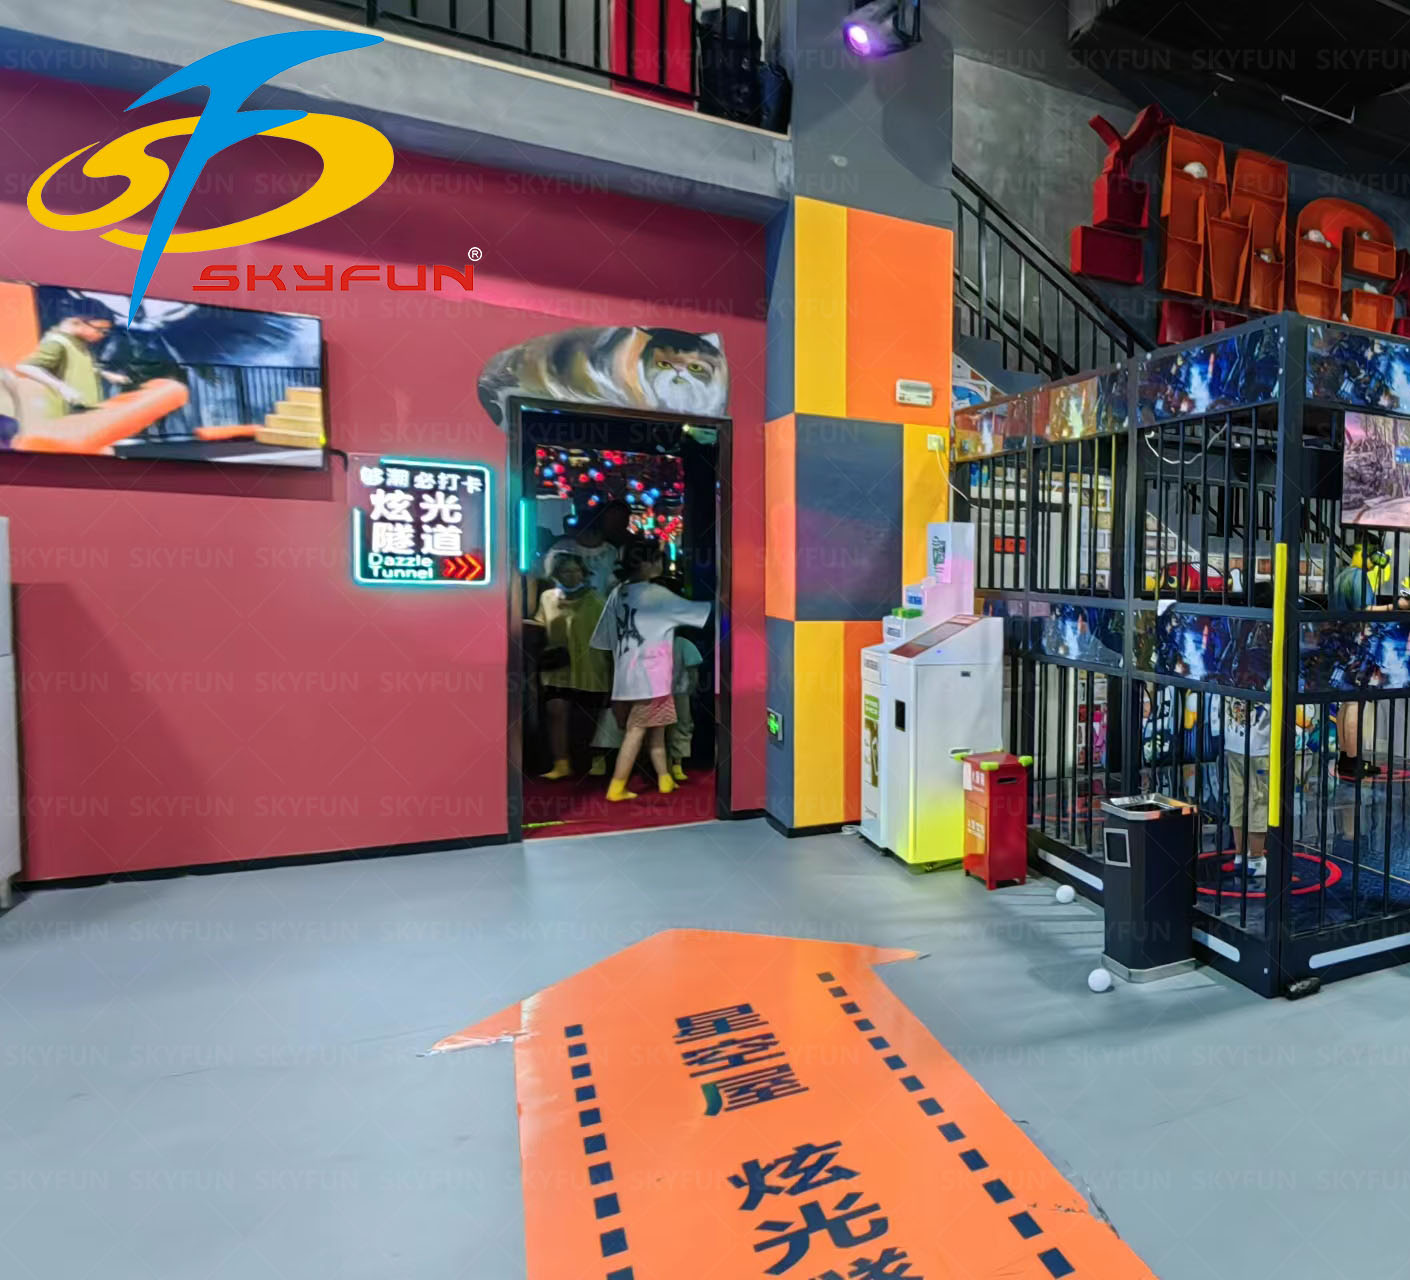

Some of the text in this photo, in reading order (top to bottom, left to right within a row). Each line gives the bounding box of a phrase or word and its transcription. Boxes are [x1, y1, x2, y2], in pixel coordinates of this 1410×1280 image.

[370, 488, 462, 523] 炫光
[371, 522, 463, 556] 隧道
[368, 552, 433, 567] Dazzle
[370, 566, 434, 579] Tunnel
[673, 1003, 809, 1116] 星空屋
